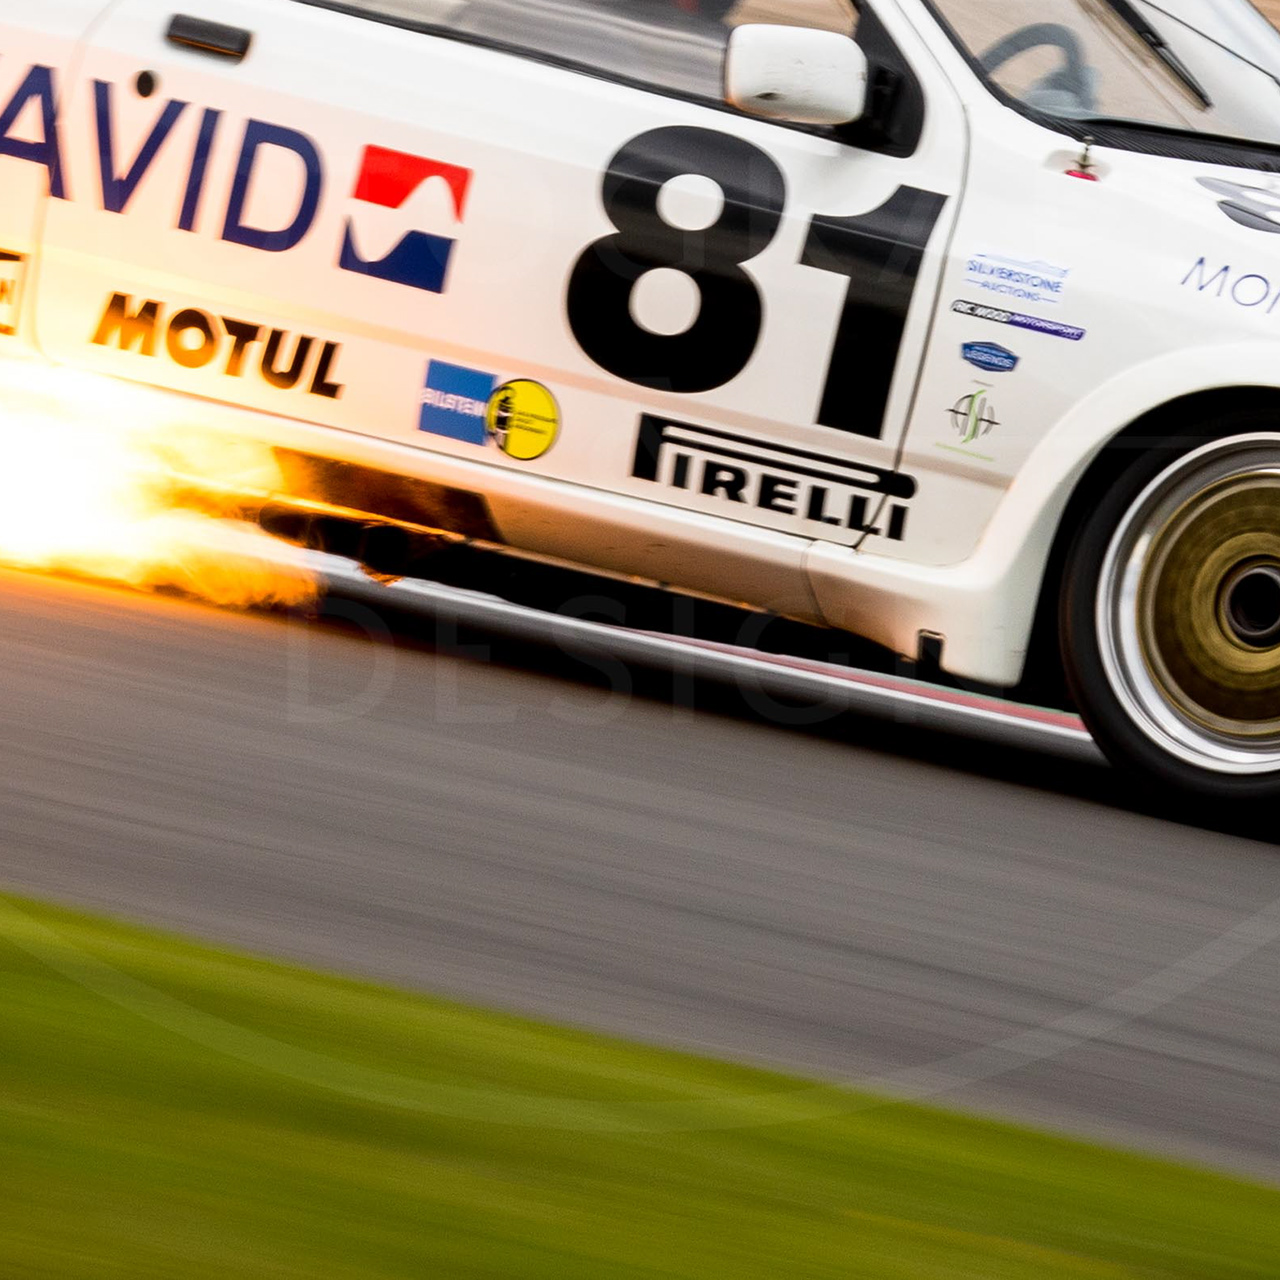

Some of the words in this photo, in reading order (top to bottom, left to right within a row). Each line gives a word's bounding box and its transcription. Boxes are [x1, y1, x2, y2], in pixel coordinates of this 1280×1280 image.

[565, 124, 951, 440] 81
[966, 259, 1064, 294] SILVERSTONE
[91, 292, 345, 400] MOTUL
[631, 411, 920, 542] PIRELLI
